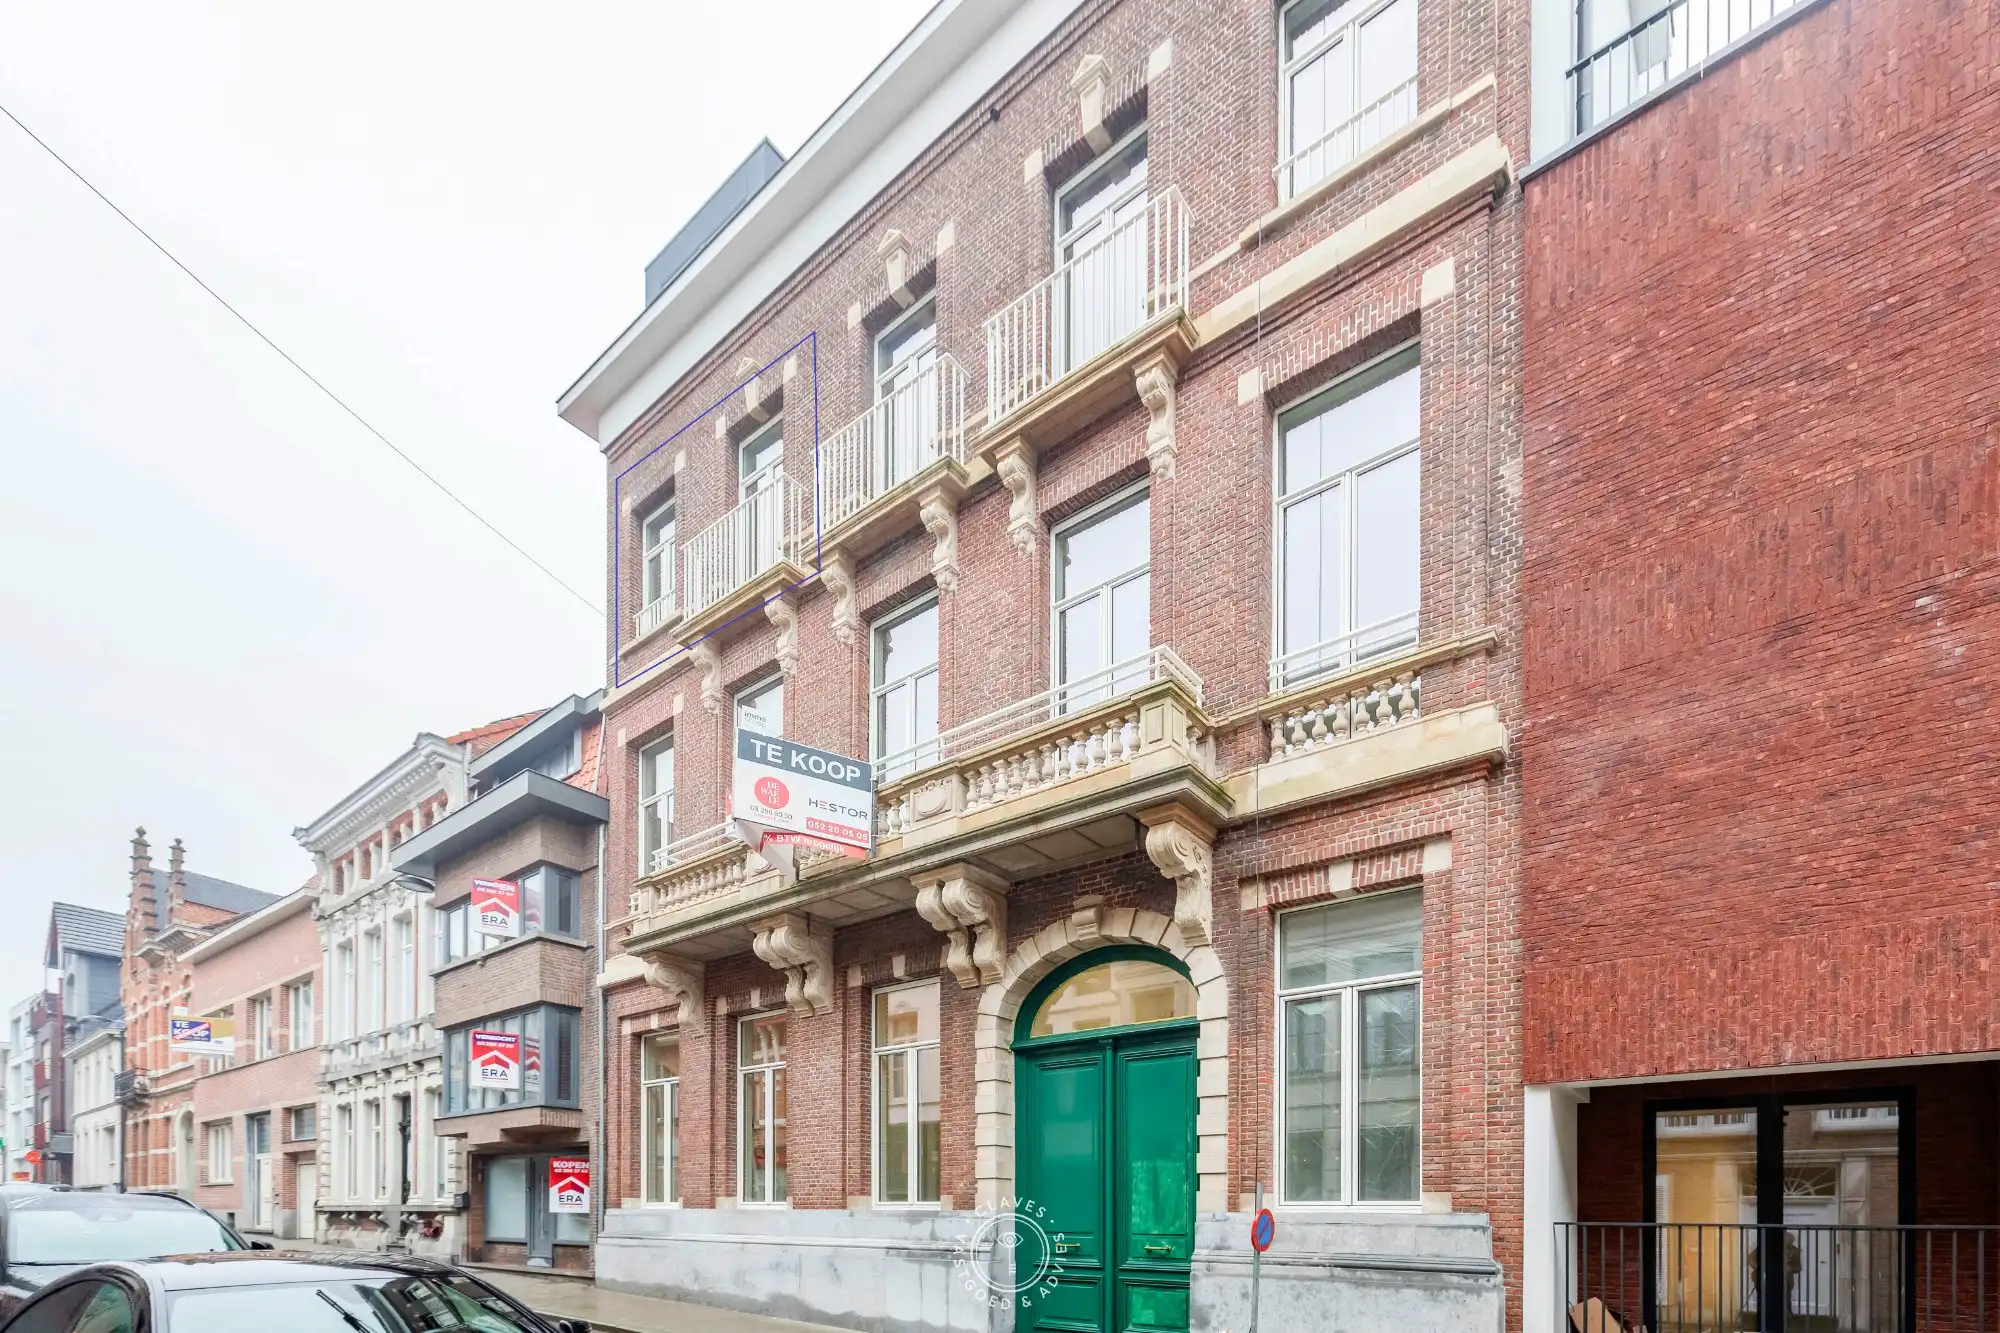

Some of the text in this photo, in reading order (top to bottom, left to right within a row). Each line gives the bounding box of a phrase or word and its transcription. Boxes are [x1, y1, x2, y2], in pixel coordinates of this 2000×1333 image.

[750, 738, 861, 782] TE KOOP
[767, 780, 780, 791] DE
[760, 786, 780, 797] WAE
[808, 797, 868, 820] HESTOR
[808, 820, 868, 841] 052 20 05 05
[776, 834, 801, 843] BTW
[803, 838, 845, 853] mogelijk
[481, 915, 508, 926] ERA
[173, 1020, 190, 1028] TE
[482, 1068, 508, 1077] ERA
[552, 1160, 590, 1169] KOPEN
[558, 1194, 583, 1203] ERA
